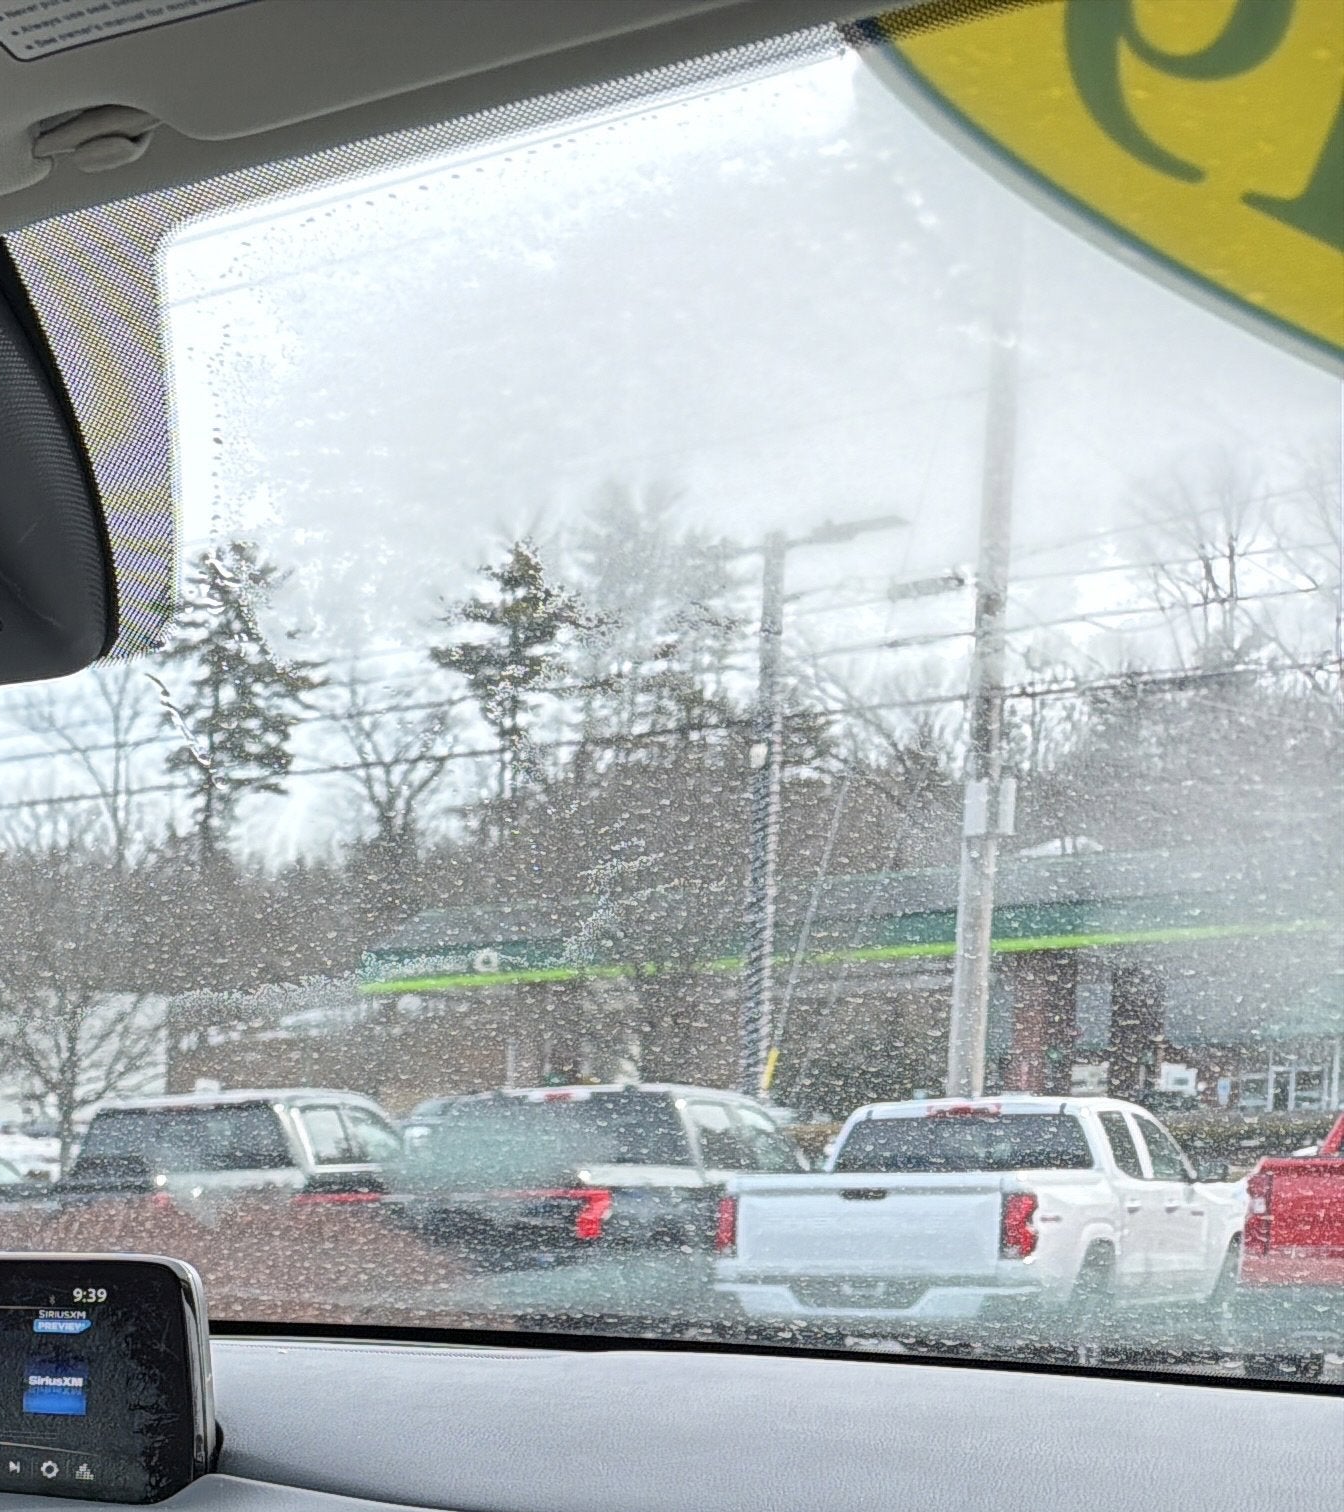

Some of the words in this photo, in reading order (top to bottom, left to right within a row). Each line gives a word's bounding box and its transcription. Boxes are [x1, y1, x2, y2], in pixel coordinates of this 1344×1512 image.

[73, 1287, 107, 1304] 9:39
[38, 1310, 86, 1319] SIRIUSXM
[28, 1375, 83, 1387] SiriusXM
